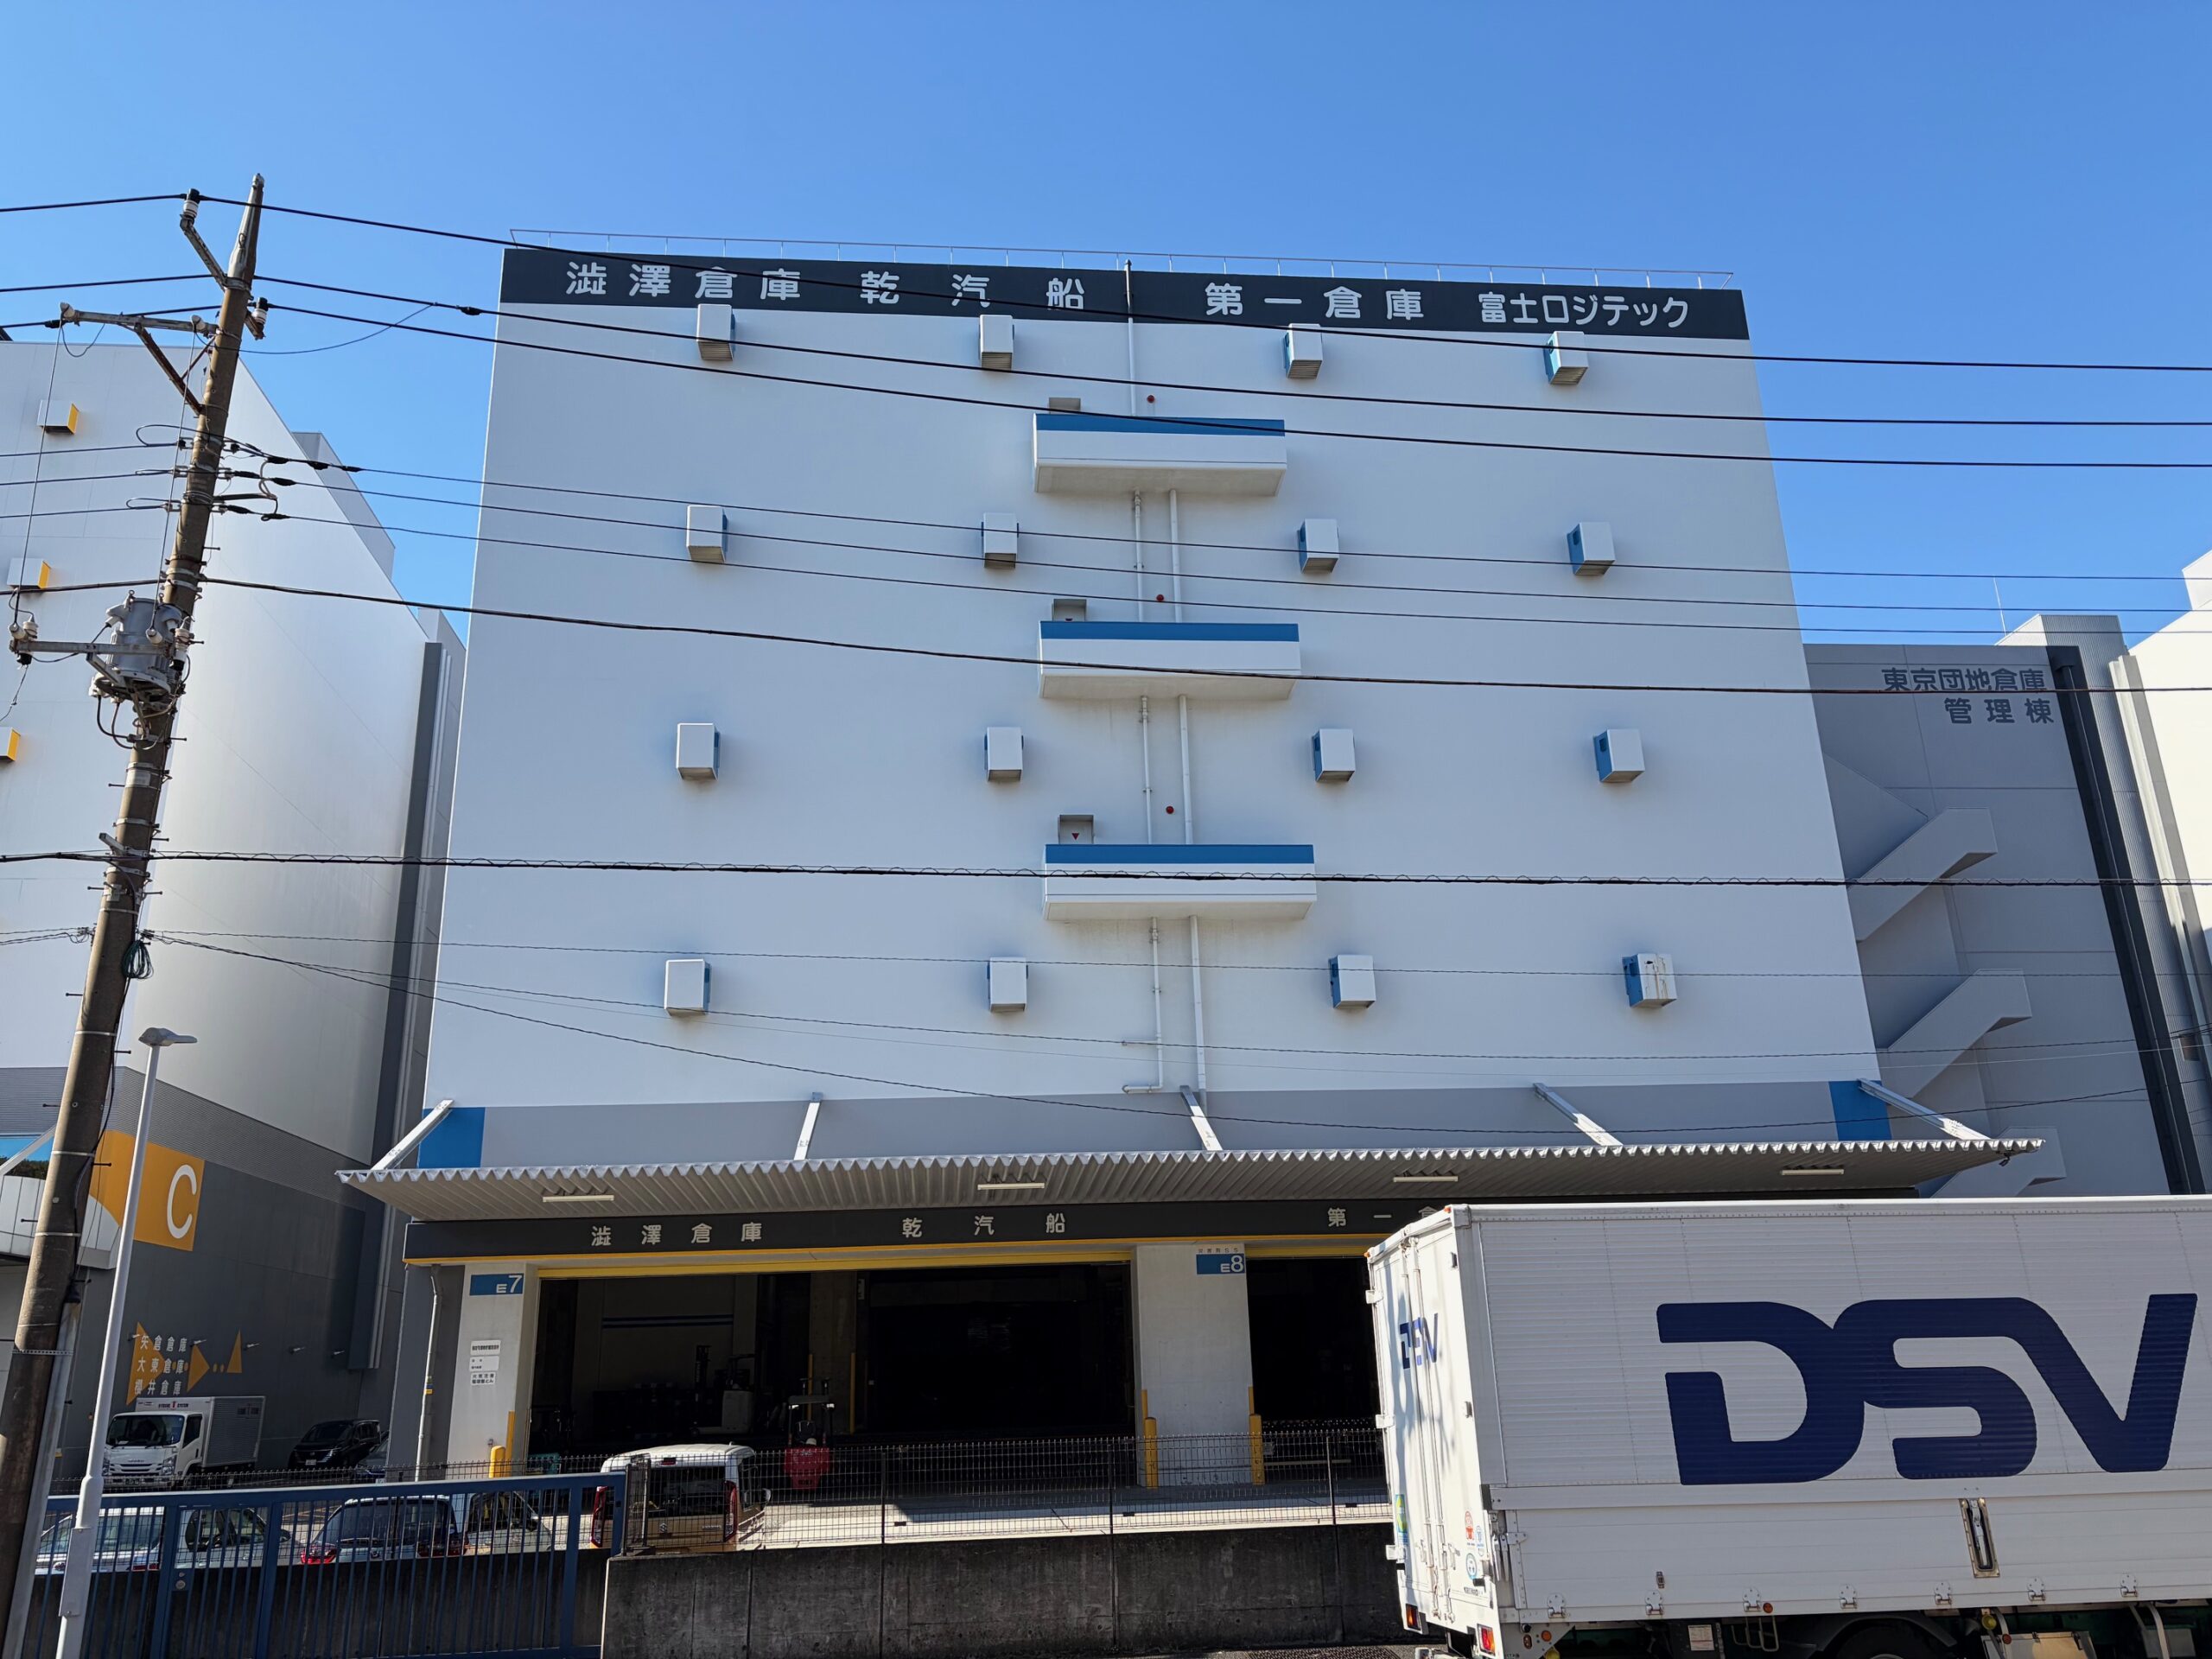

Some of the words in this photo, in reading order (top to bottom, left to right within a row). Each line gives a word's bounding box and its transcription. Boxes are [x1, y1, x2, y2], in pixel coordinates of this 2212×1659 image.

[860, 270, 1084, 309] 乾汽船
[1205, 283, 1425, 321] 第一倉庫
[1478, 293, 1689, 328] 富士ロジテック
[1881, 668, 2048, 694] 東京団地倉庫
[1944, 697, 2055, 724] 管理棟
[167, 1164, 198, 1239] C
[902, 1212, 1066, 1238] 乾汽船
[1220, 1255, 1244, 1273] E8
[496, 1274, 523, 1294] E7
[1656, 1293, 2198, 1485] DSV
